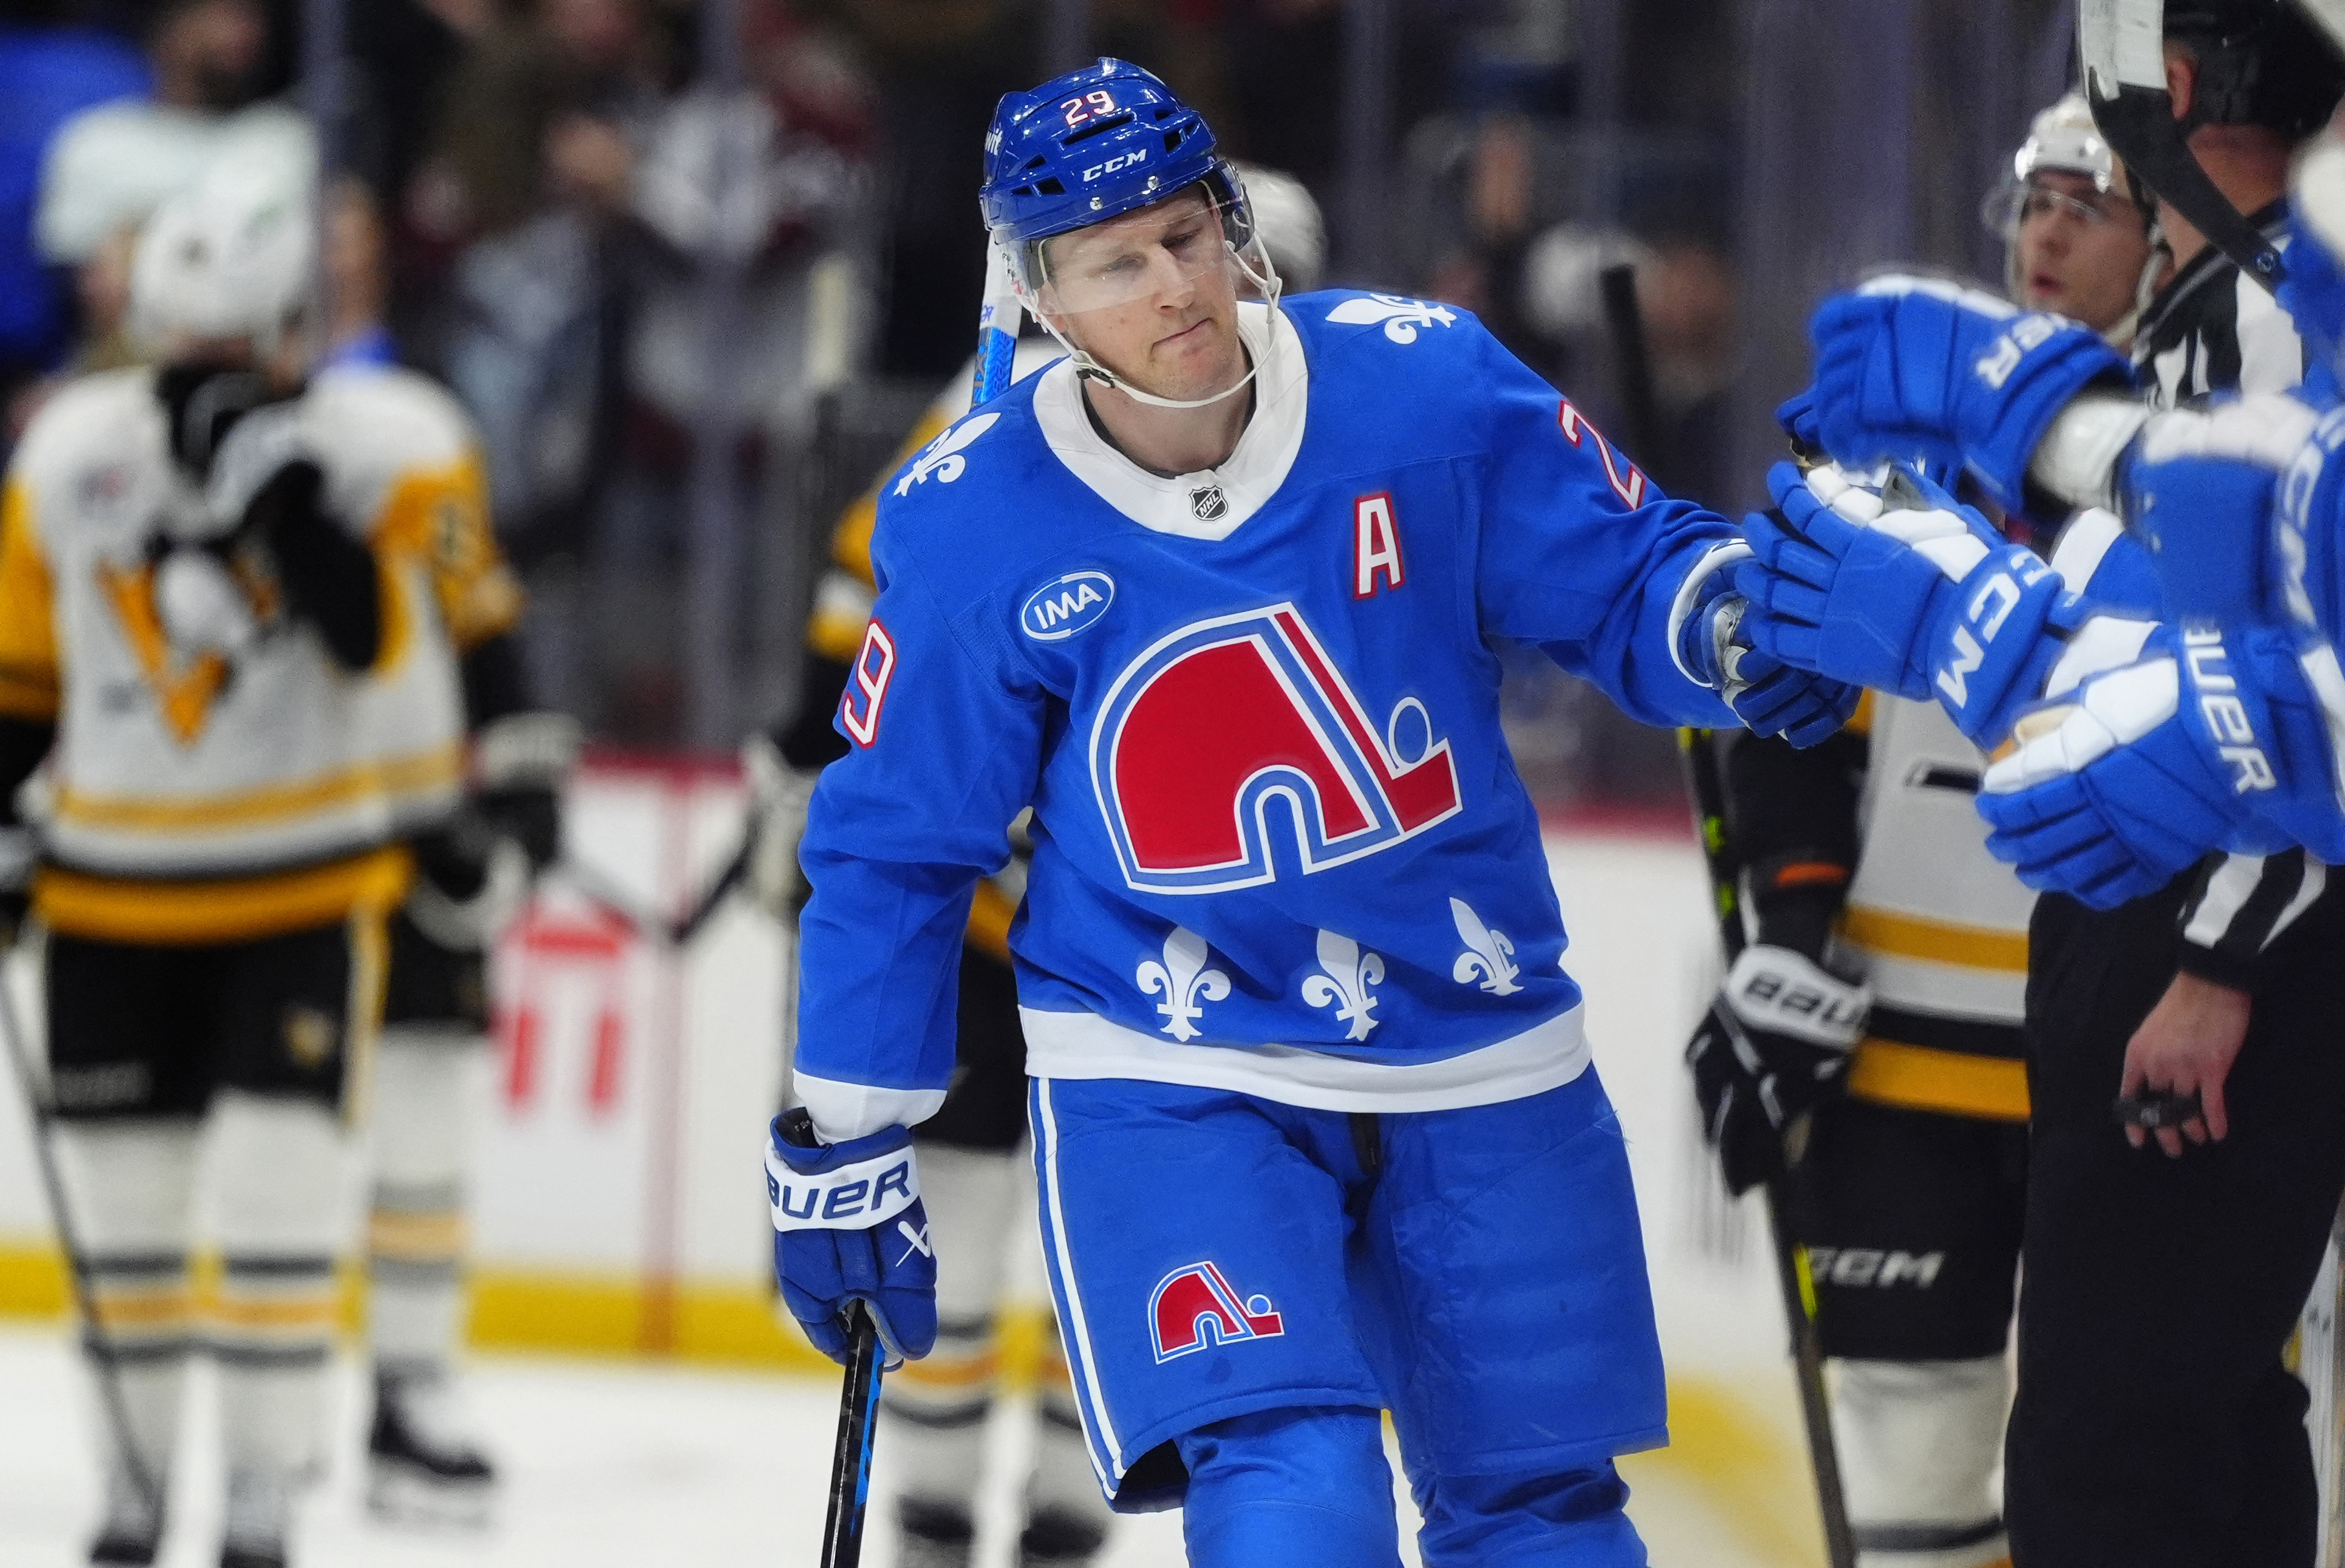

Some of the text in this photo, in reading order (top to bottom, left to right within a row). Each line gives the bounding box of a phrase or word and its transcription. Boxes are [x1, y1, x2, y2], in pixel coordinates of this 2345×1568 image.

[1060, 89, 1116, 126] 29
[1082, 148, 1147, 182] CCM
[1198, 493, 1220, 517] NHL
[1354, 491, 1405, 600] A
[1034, 583, 1104, 630] IMA
